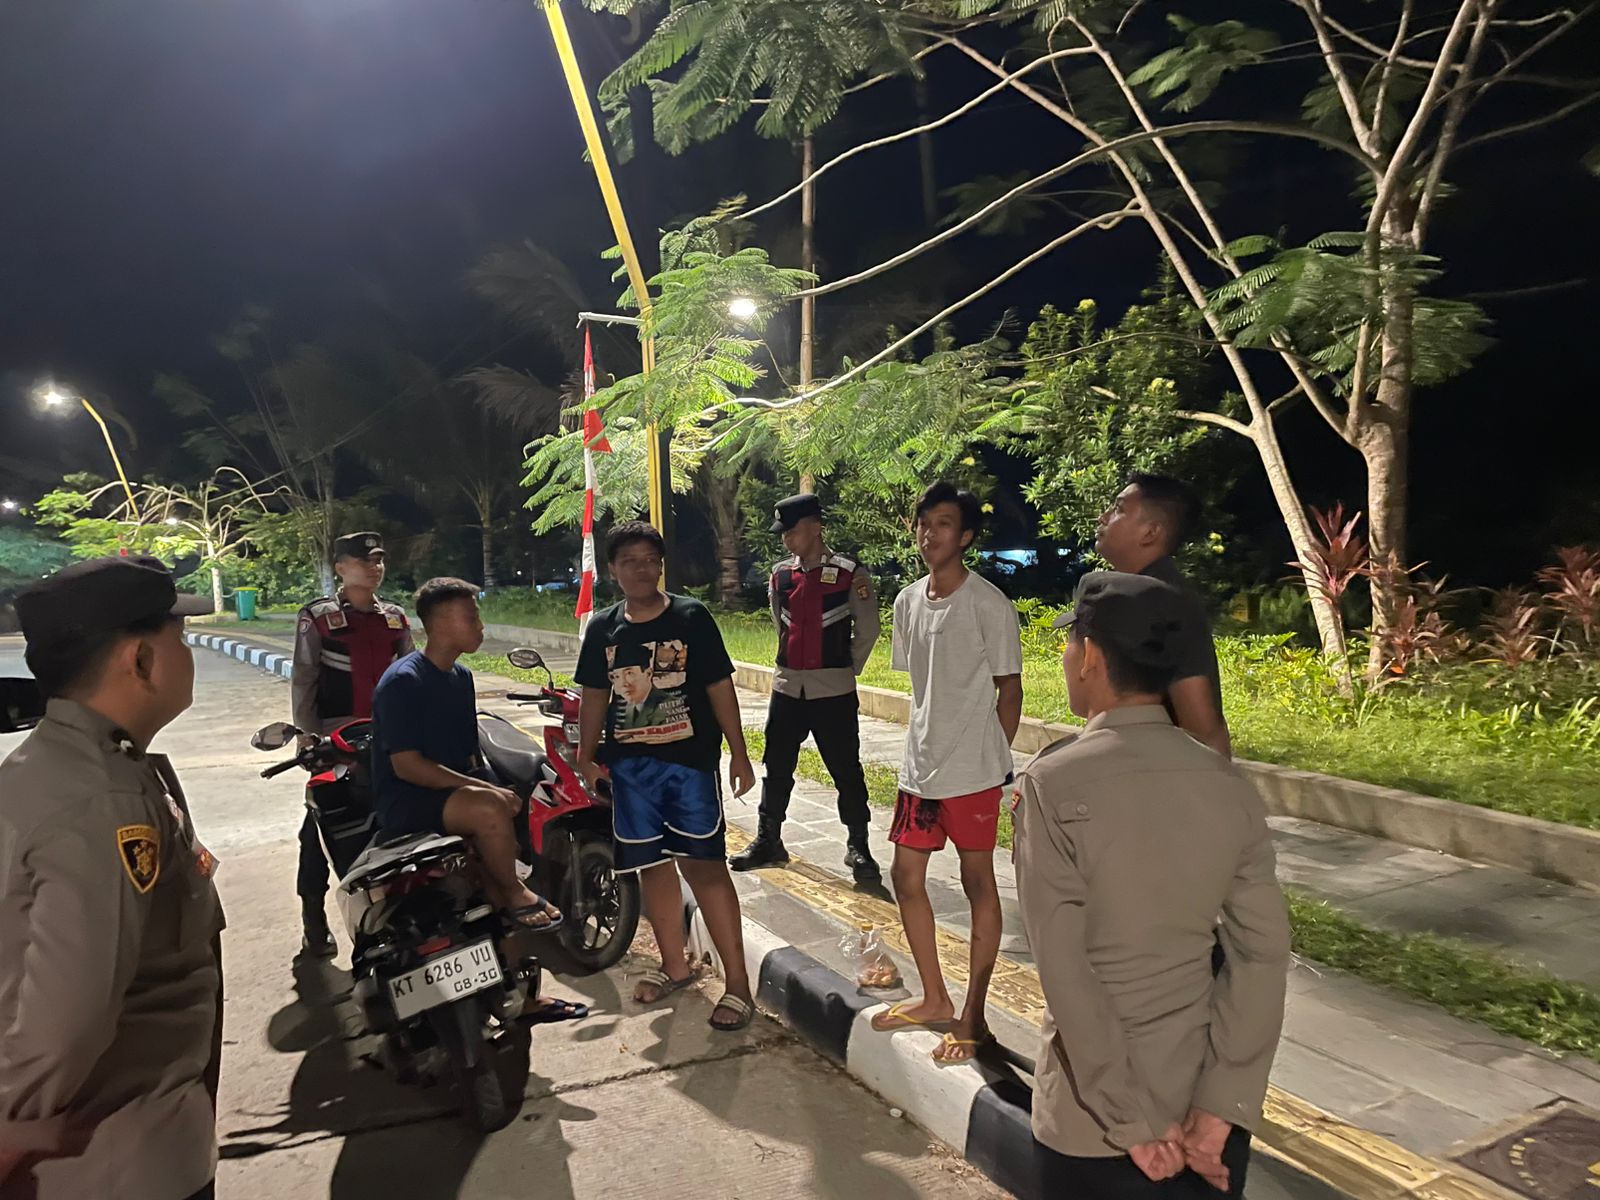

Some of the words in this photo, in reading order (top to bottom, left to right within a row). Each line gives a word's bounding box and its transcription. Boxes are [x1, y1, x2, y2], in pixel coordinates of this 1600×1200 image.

[392, 976, 414, 998] KT
[424, 957, 463, 985] 6286
[470, 945, 491, 966] VU
